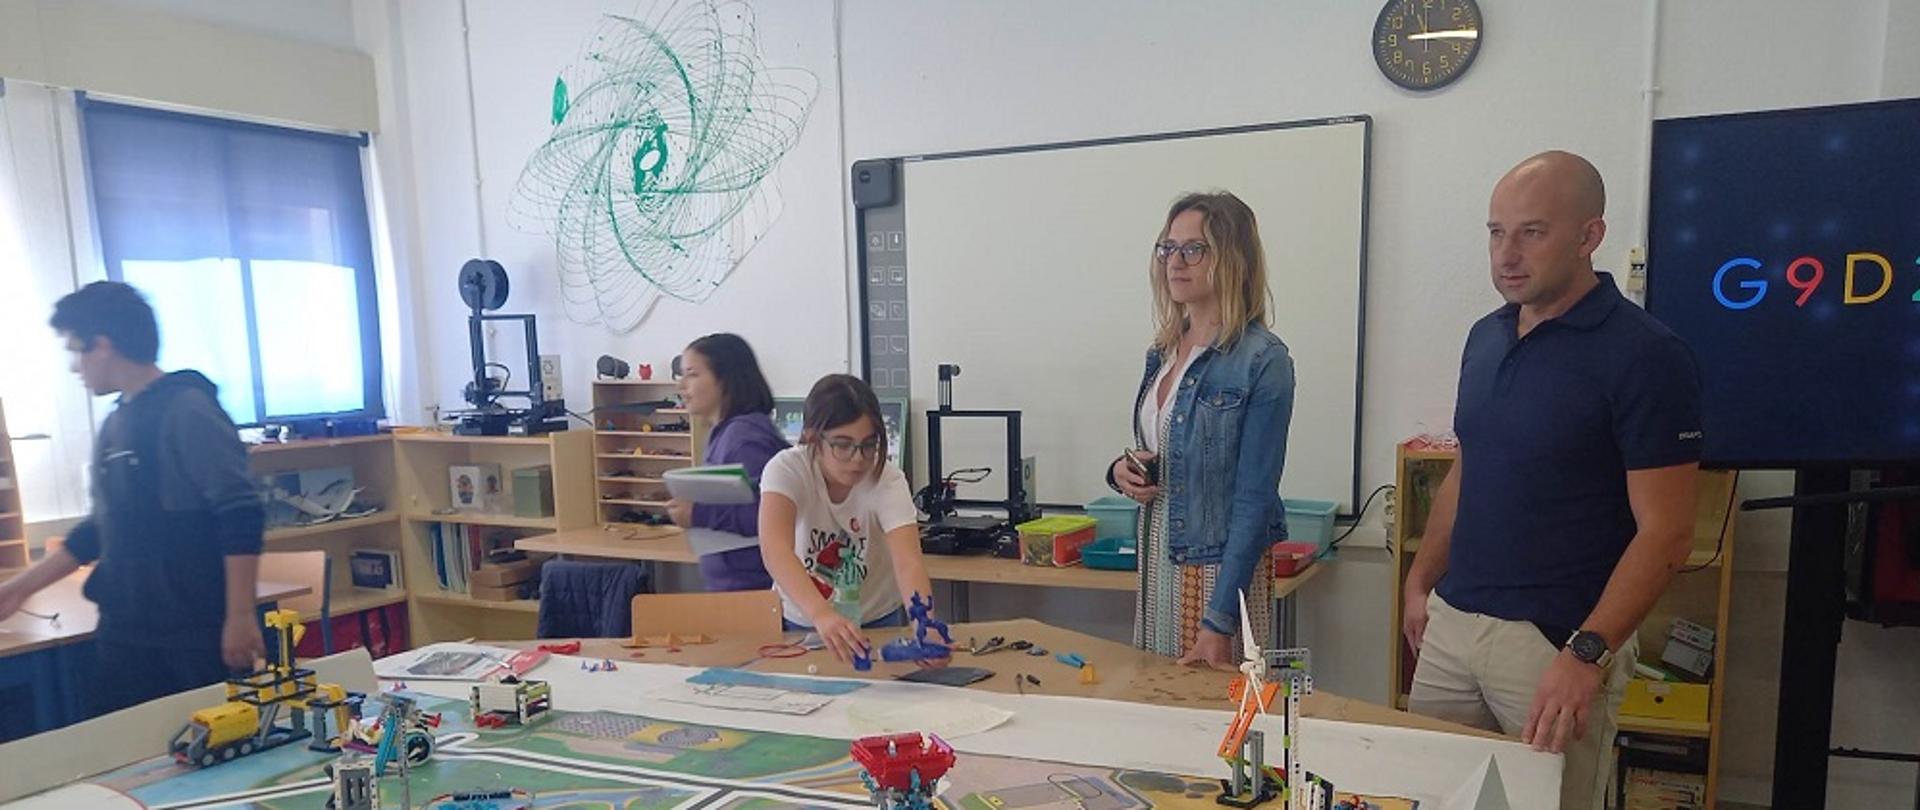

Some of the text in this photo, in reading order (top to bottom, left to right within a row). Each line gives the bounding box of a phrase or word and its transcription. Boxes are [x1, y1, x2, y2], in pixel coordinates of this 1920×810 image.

[1451, 7, 1462, 21] 2
[1391, 16, 1403, 30] 10
[1388, 34, 1397, 47] 9
[1451, 42, 1461, 55] 4
[1393, 50, 1402, 64] 8
[1439, 55, 1449, 69] 5
[1405, 59, 1414, 72] 7
[1422, 60, 1432, 75] 6
[1712, 251, 1920, 310] G9D
